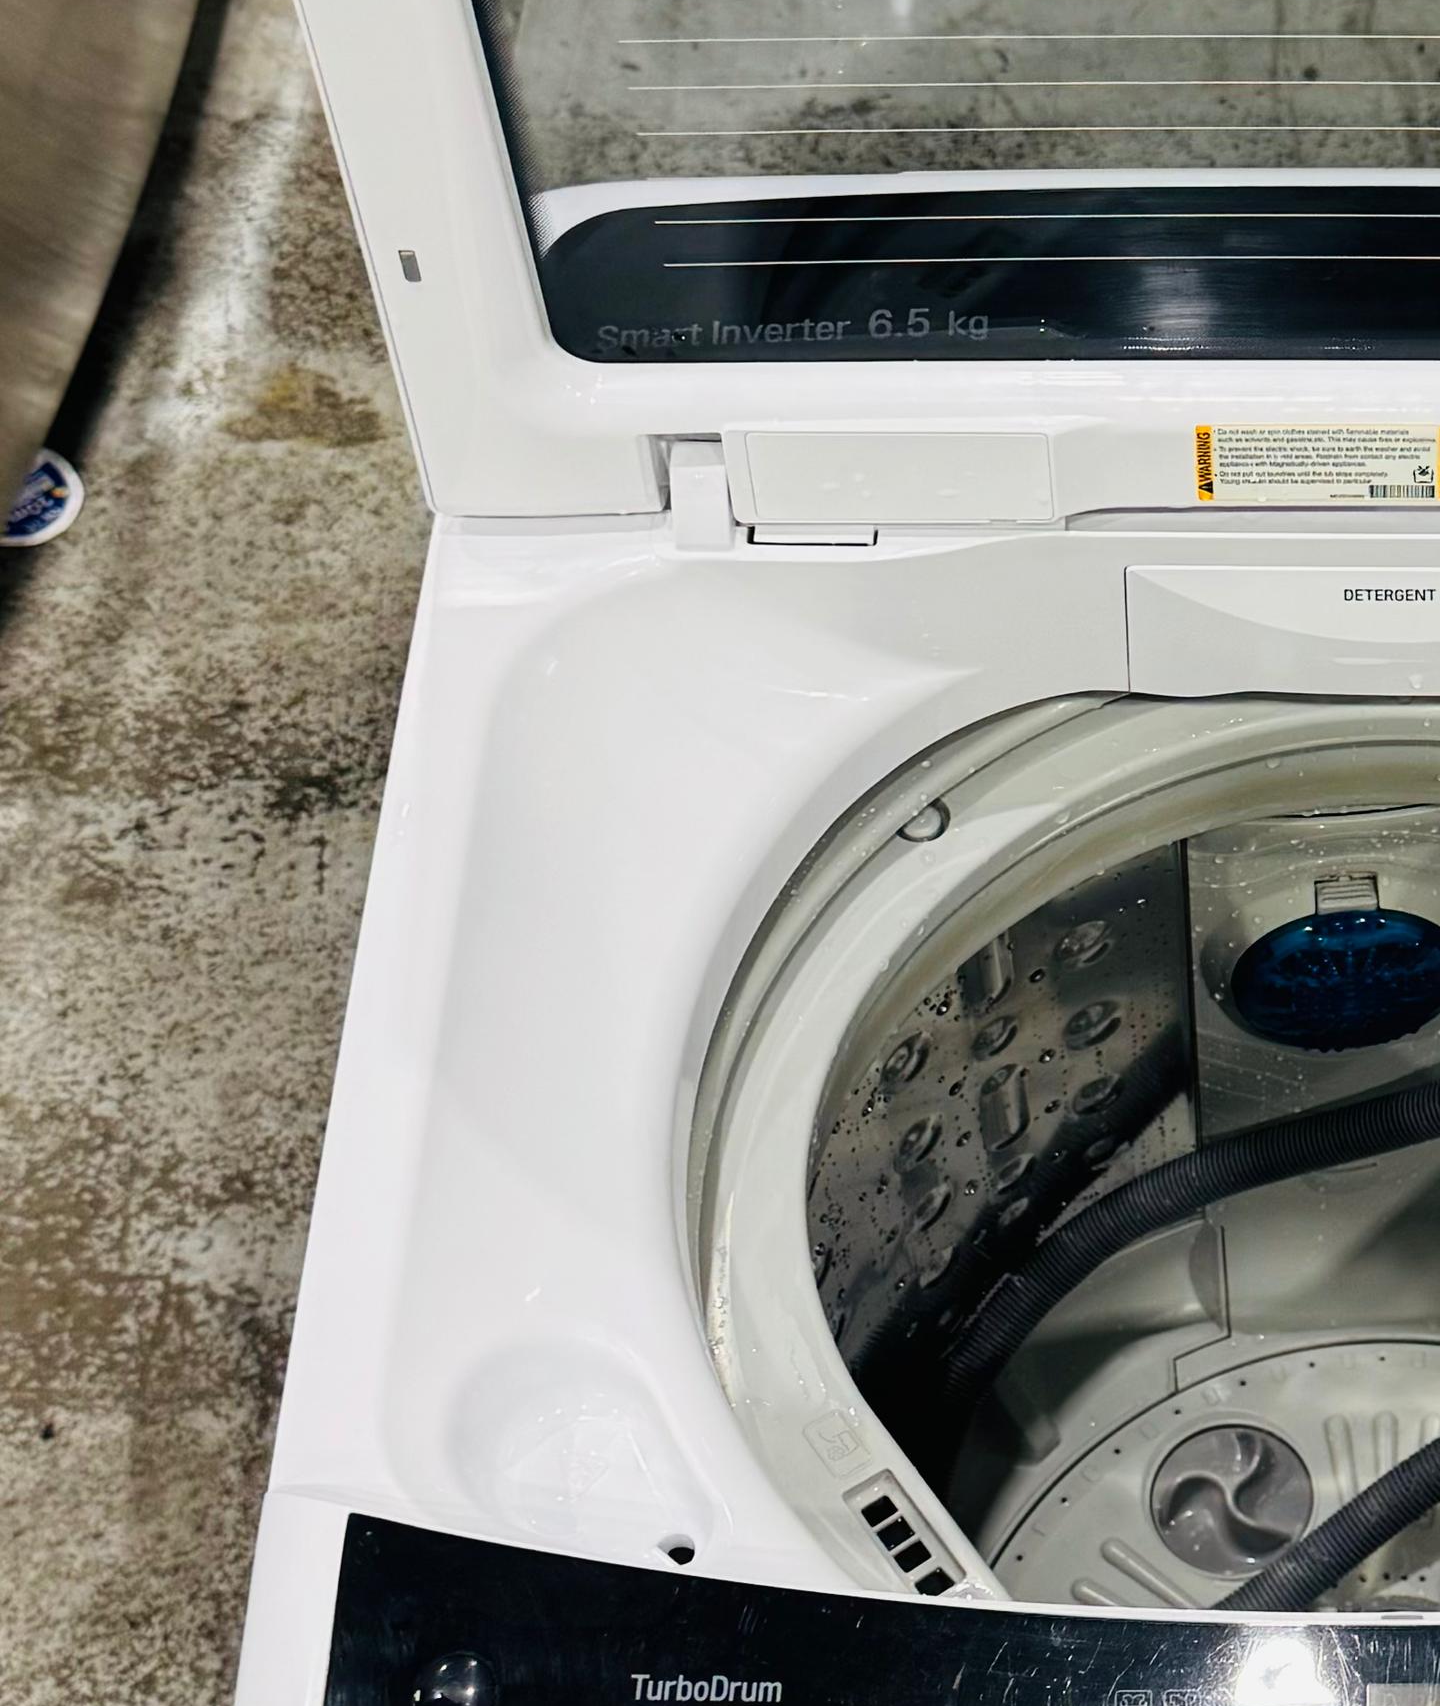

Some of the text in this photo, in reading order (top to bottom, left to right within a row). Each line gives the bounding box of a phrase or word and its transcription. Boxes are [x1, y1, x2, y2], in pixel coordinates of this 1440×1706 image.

[597, 307, 990, 352] Smart Inverter 6.5 kg
[1197, 431, 1211, 482] WARNING
[1343, 588, 1437, 603] DETERGENT
[630, 1673, 783, 1704] TurboDrum
